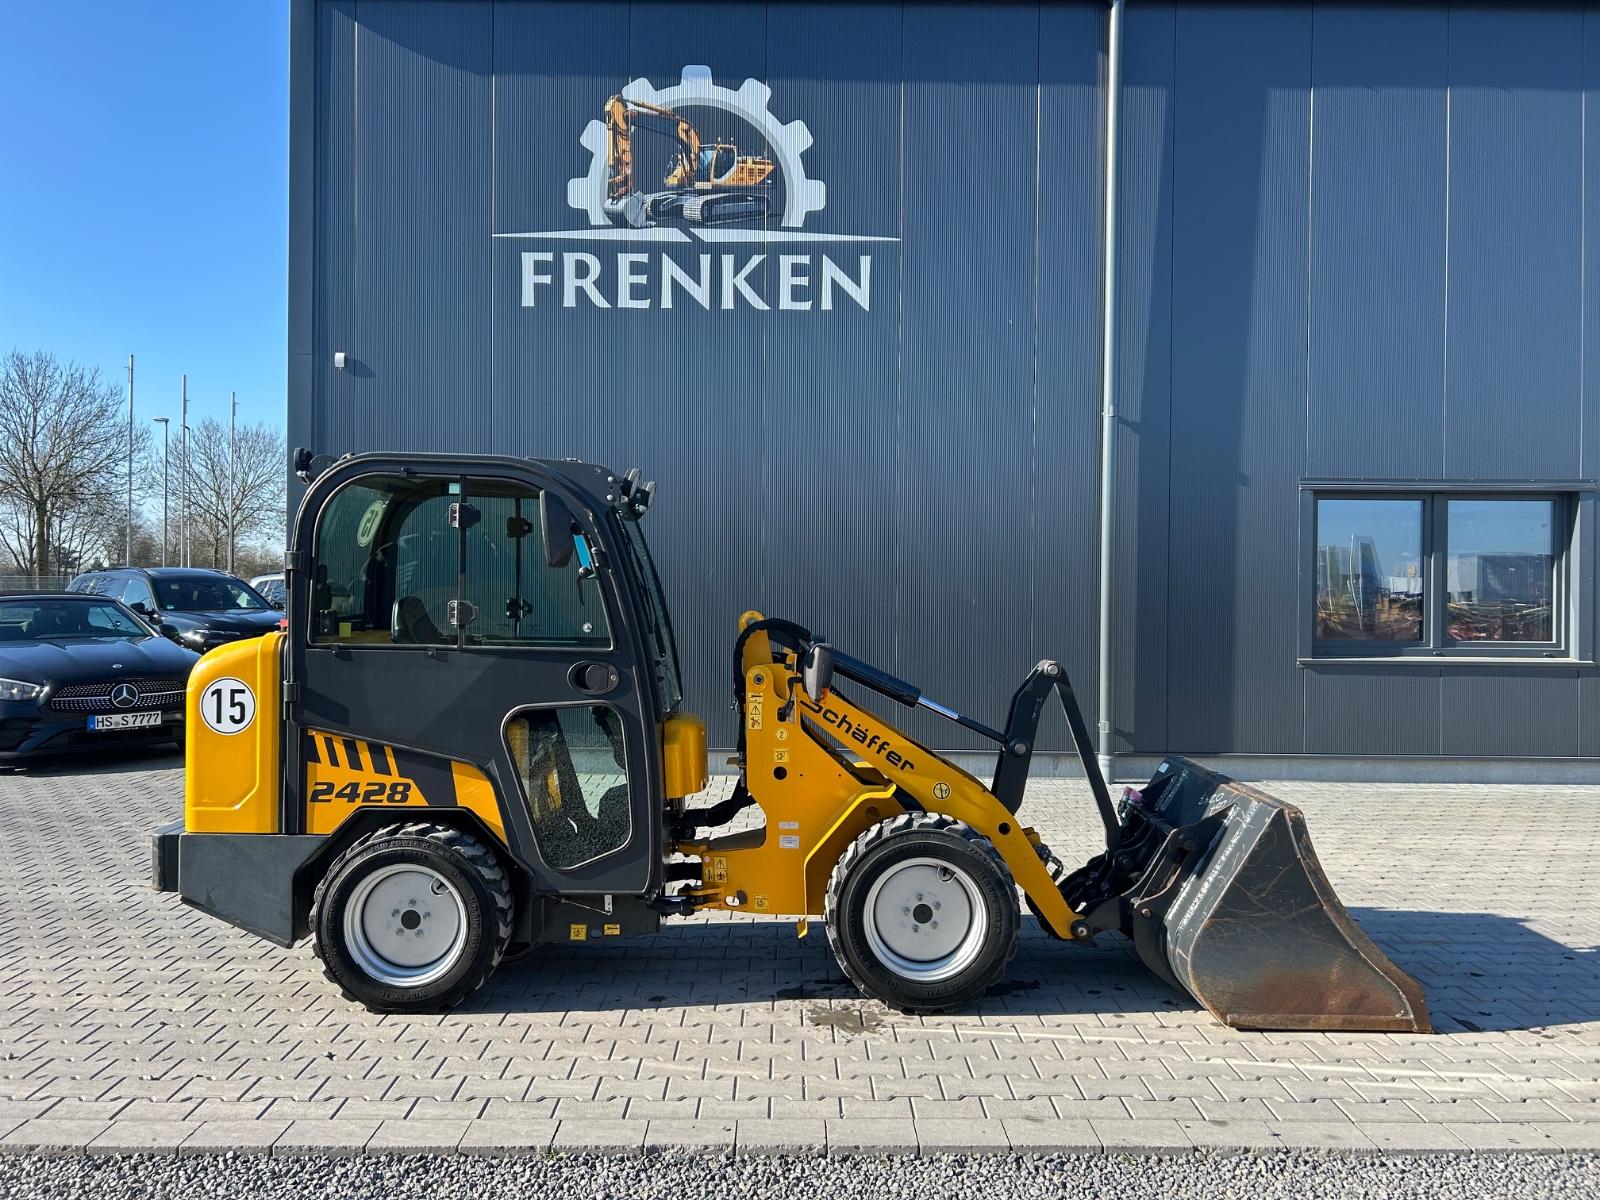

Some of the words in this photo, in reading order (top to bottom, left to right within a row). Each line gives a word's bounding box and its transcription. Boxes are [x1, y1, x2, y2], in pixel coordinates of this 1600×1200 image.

[521, 252, 872, 311] FRENKEN
[96, 716, 113, 728] HS
[121, 715, 129, 726] S
[131, 712, 160, 726] 7777
[211, 688, 246, 725] 15
[310, 781, 411, 803] 2428
